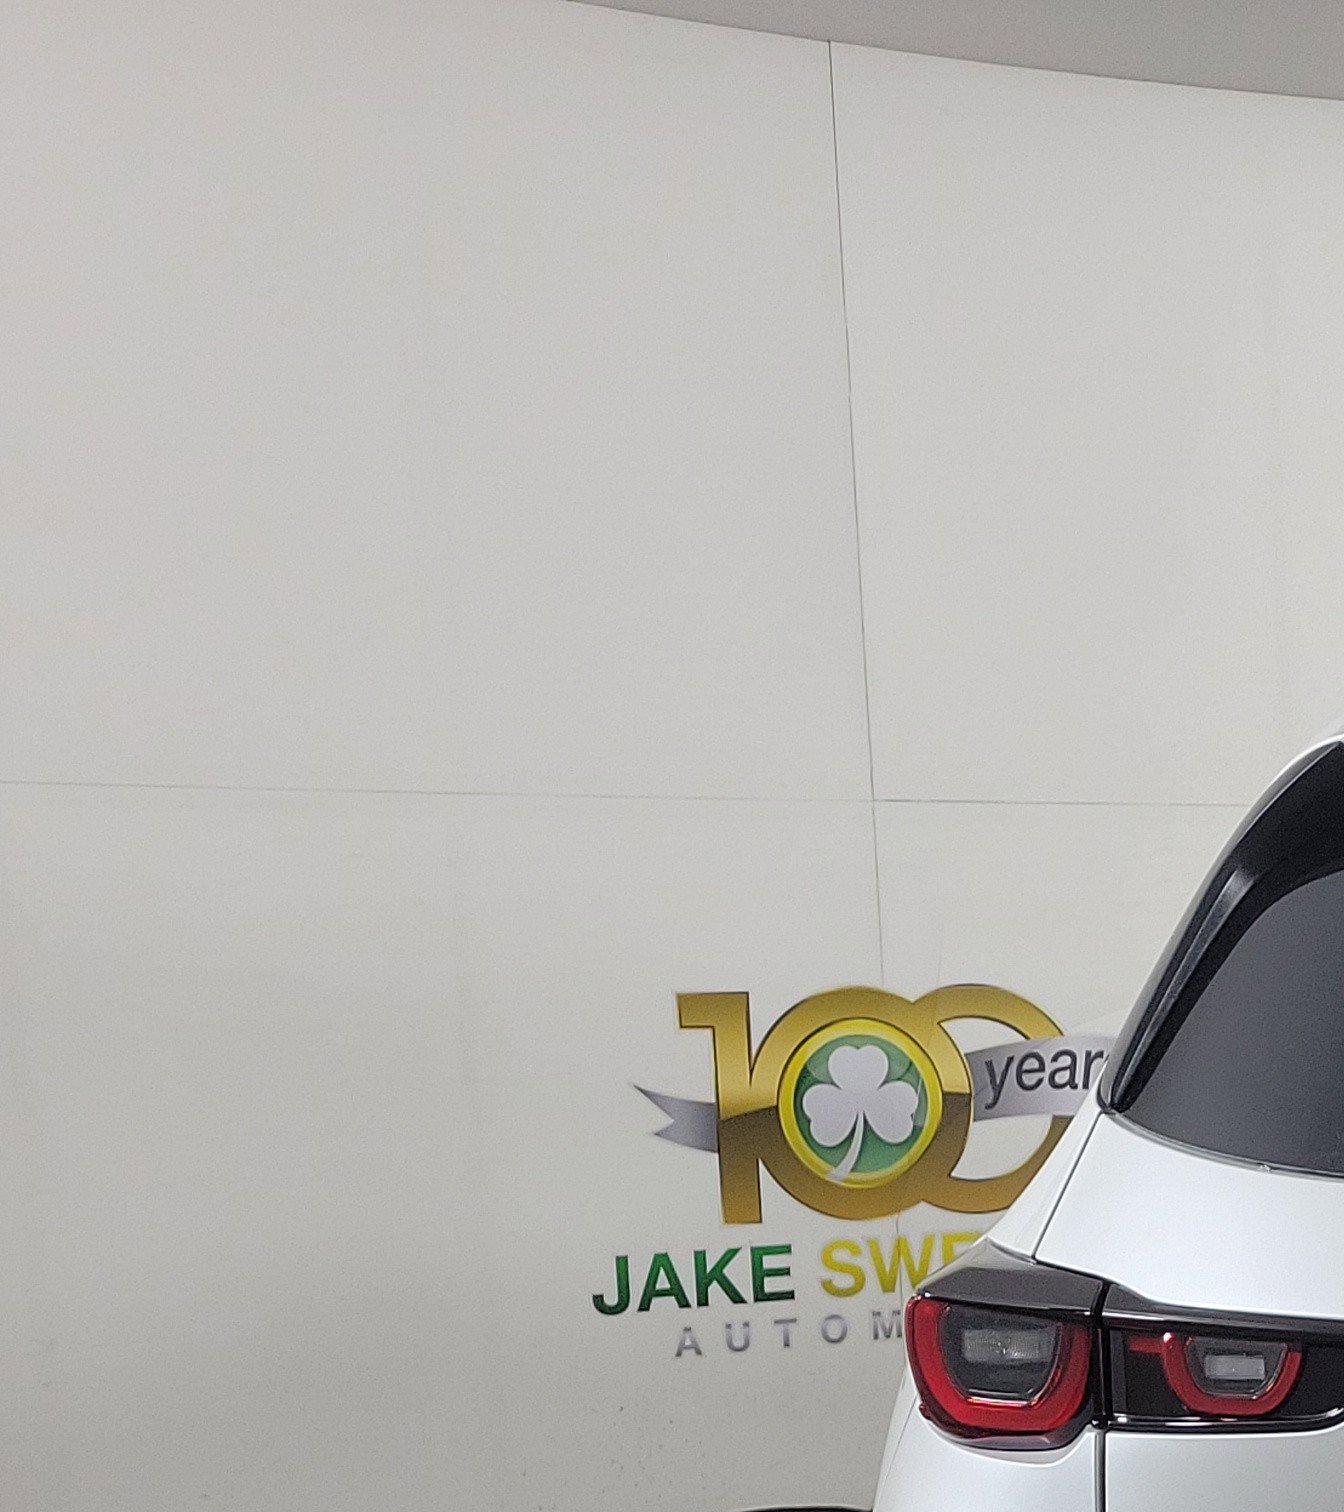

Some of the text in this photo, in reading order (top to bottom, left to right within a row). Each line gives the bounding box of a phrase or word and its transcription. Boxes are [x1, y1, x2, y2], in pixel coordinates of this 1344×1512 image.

[675, 983, 1109, 1225] 100 year
[591, 1243, 796, 1316] JAKE
